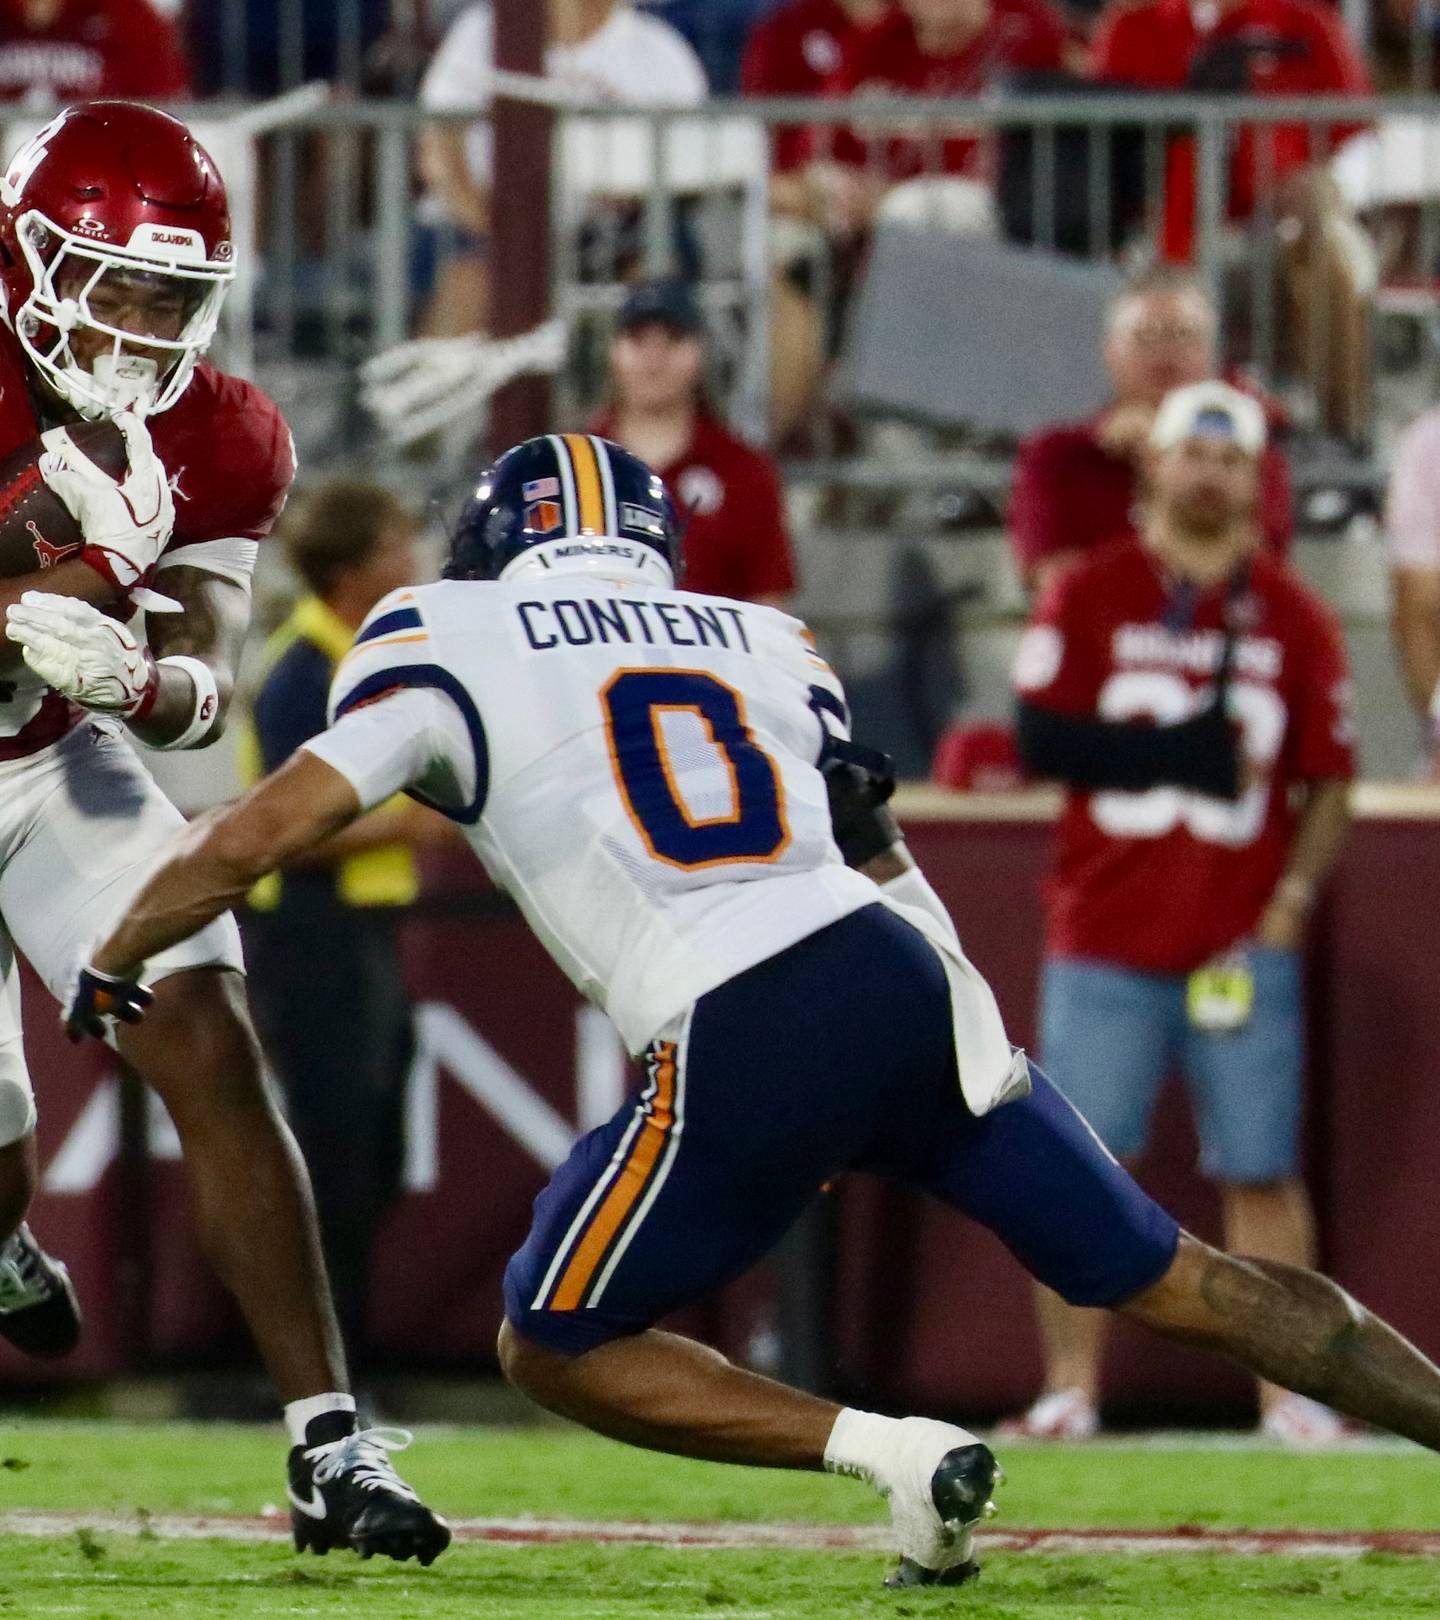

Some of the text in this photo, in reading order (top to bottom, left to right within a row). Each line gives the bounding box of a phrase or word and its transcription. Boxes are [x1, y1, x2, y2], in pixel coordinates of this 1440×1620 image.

[71, 225, 110, 240] OAKLEY
[151, 231, 194, 247] OKLAHOMA
[556, 544, 633, 559] MINERS
[516, 598, 752, 653] CONTENT
[598, 666, 793, 873] 0
